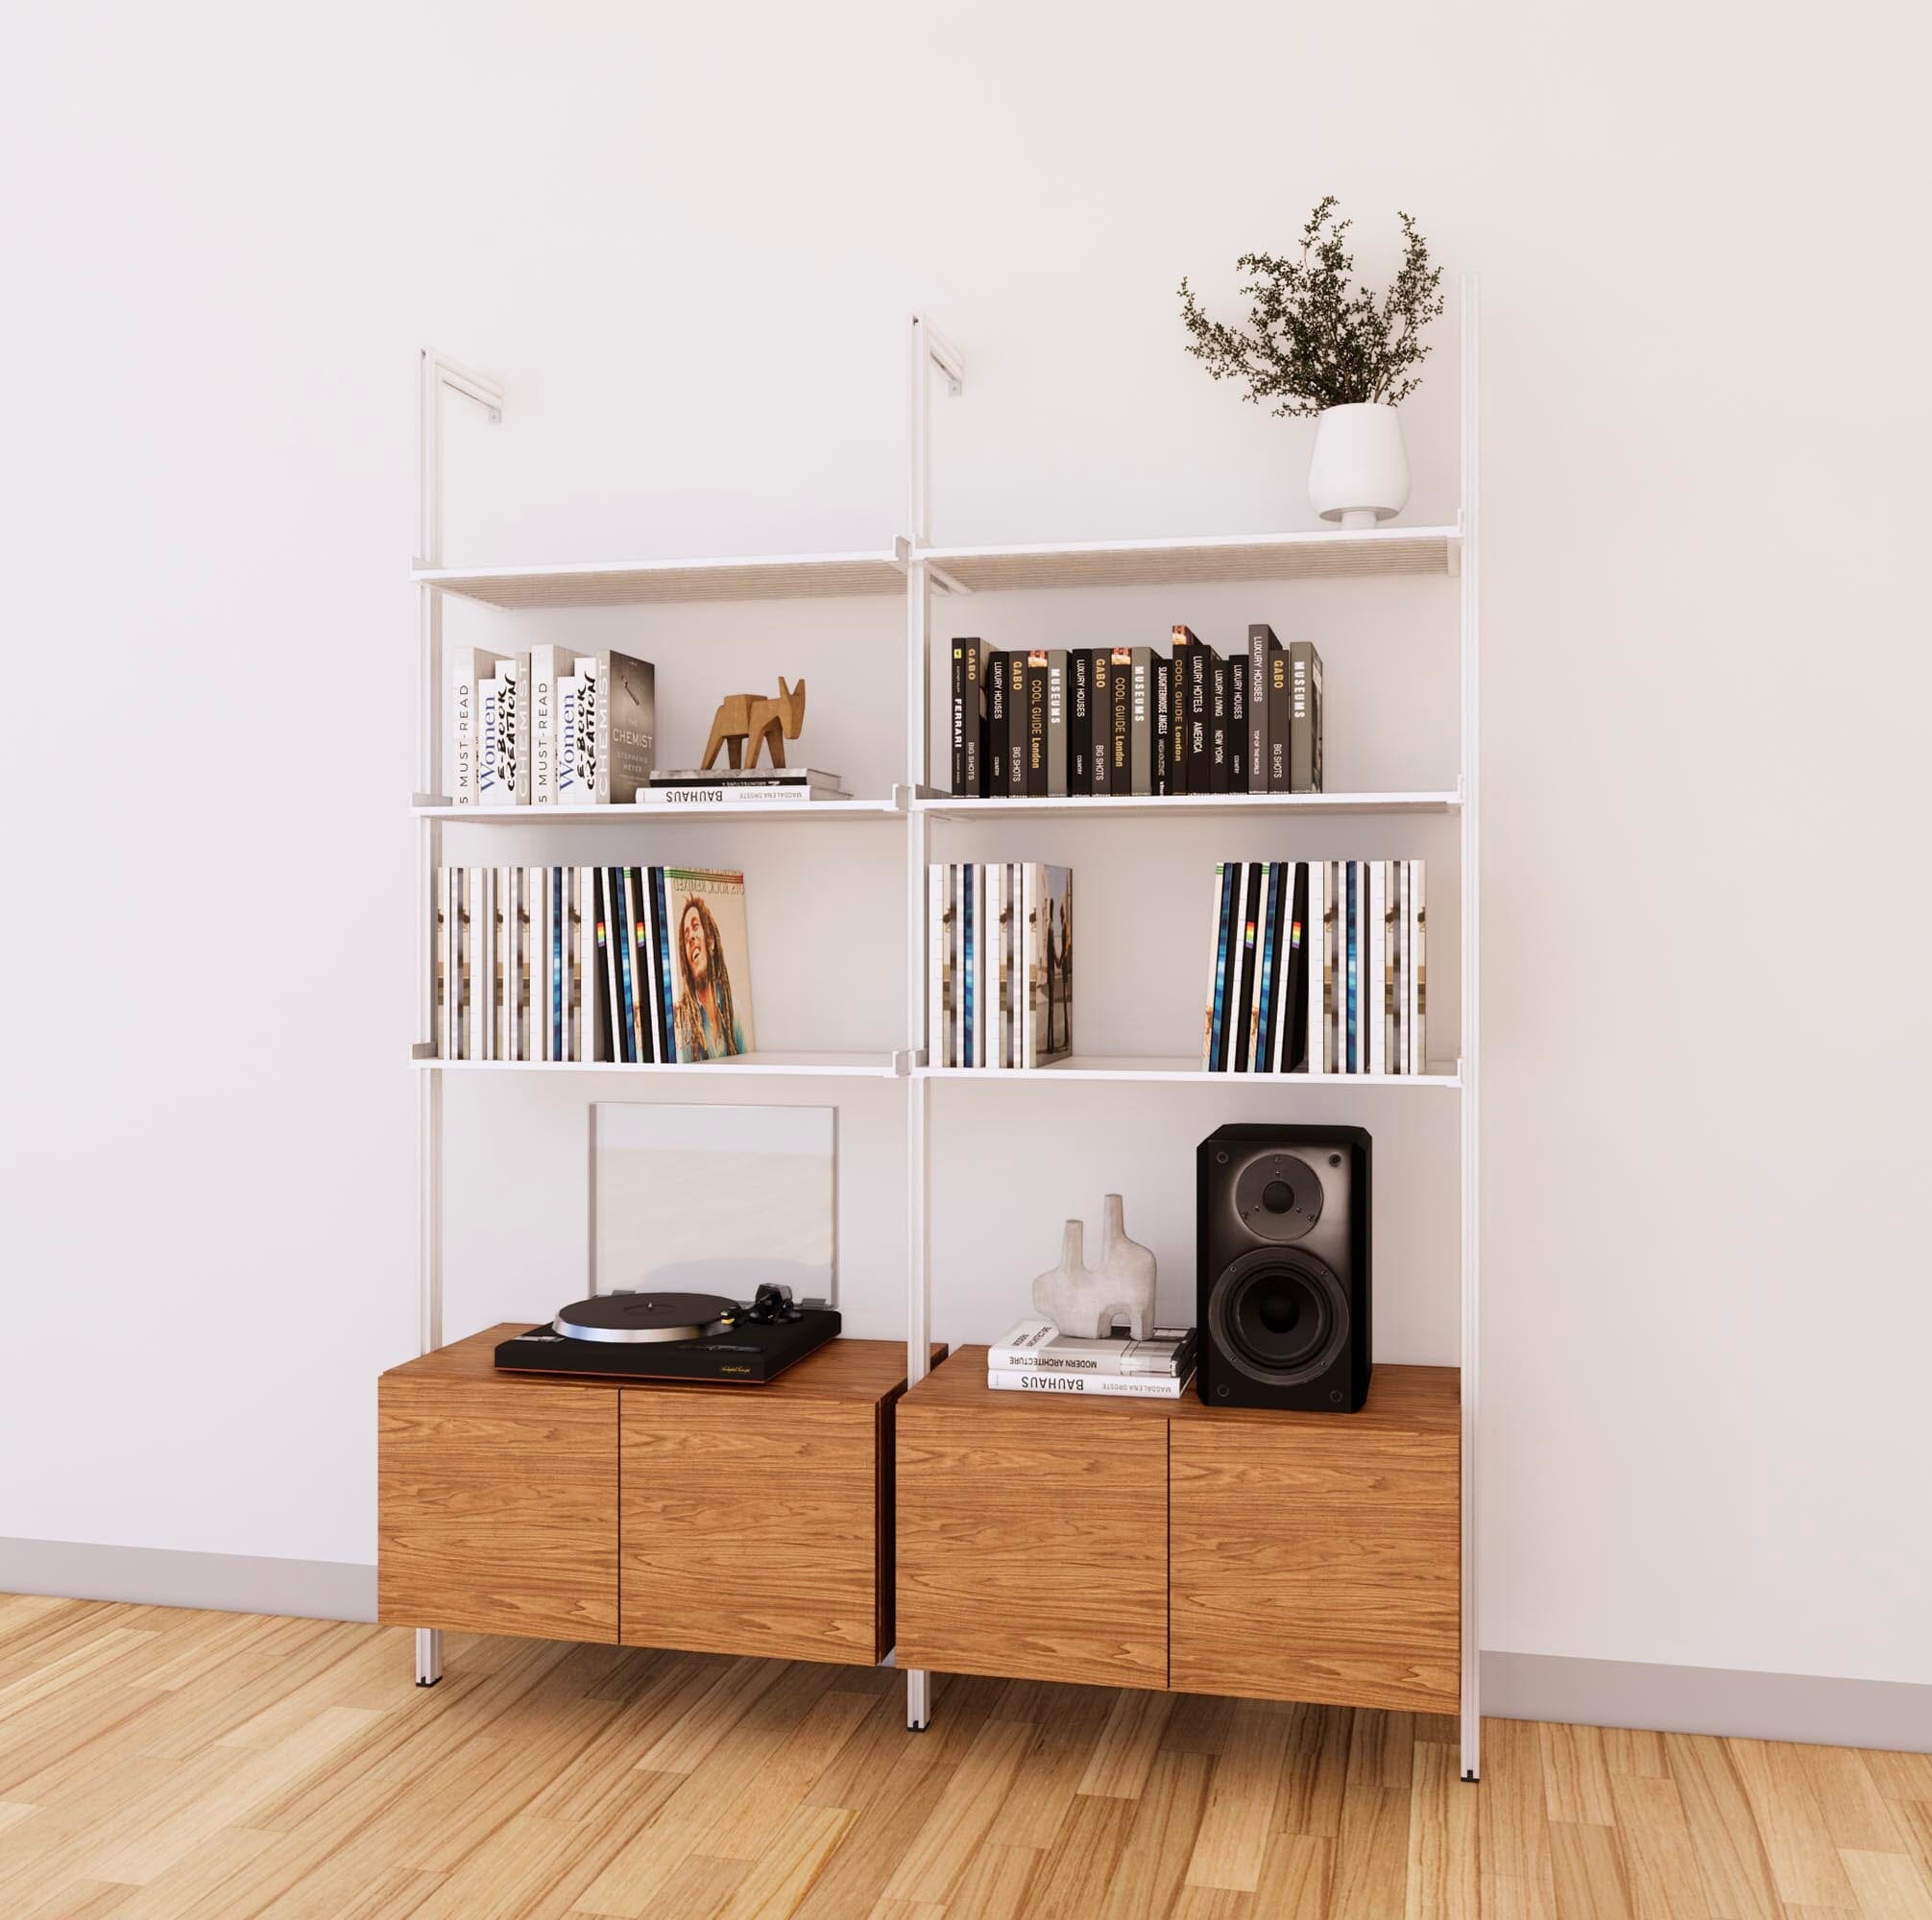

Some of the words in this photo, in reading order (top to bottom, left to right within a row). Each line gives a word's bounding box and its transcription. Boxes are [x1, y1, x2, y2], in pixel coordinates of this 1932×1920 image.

[1012, 660, 1023, 691] GABO
[1096, 659, 1106, 688] GABO
[1193, 656, 1202, 683] LUXURY
[1215, 670, 1223, 693] LUXURY
[1234, 664, 1243, 691] LUXURY
[1273, 660, 1283, 689] GABO
[1031, 680, 1042, 705] COOL
[1051, 668, 1060, 724] MUSEUMS
[1116, 678, 1125, 703] COOL
[1135, 666, 1145, 722] MUSEUMS
[1193, 685, 1202, 713] HOTELS
[1294, 660, 1305, 718] MUSEUMS
[1116, 706, 1125, 732] GUIDE
[1215, 696, 1223, 717] LIVING
[1234, 692, 1243, 720] HOUSES
[497, 685, 507, 780] E-BOOK
[505, 672, 517, 791] CREATION
[519, 660, 528, 797] CHEMIST
[539, 683, 547, 785] MUST-READ
[576, 684, 587, 778] E-BOOK
[584, 670, 596, 790] CREATION
[598, 660, 607, 797] CHEMIST
[1031, 708, 1042, 734] GUIDE
[1158, 714, 1168, 735] ANGELS
[460, 684, 469, 787] MUST-READ
[480, 697, 495, 792] Women
[559, 695, 574, 791] Women
[613, 728, 653, 749] CHEMIST
[1193, 722, 1202, 754] AMERICA
[1215, 730, 1223, 745] NEW
[1012, 747, 1021, 758] BIG
[1031, 737, 1042, 768] London
[1096, 745, 1104, 756] BIG
[1116, 735, 1125, 768] London
[1215, 746, 1223, 764] YORK
[1273, 743, 1282, 756] BIG
[1012, 760, 1021, 781] SHOTS
[1096, 758, 1104, 781] SHOTS
[1273, 756, 1282, 779] SHOTS
[665, 790, 723, 803] BAUHAUS
[1009, 1356, 1064, 1367] ARCHITECTURE
[1066, 1359, 1097, 1369] MODERN
[1022, 1377, 1083, 1390] BAUHAUS
